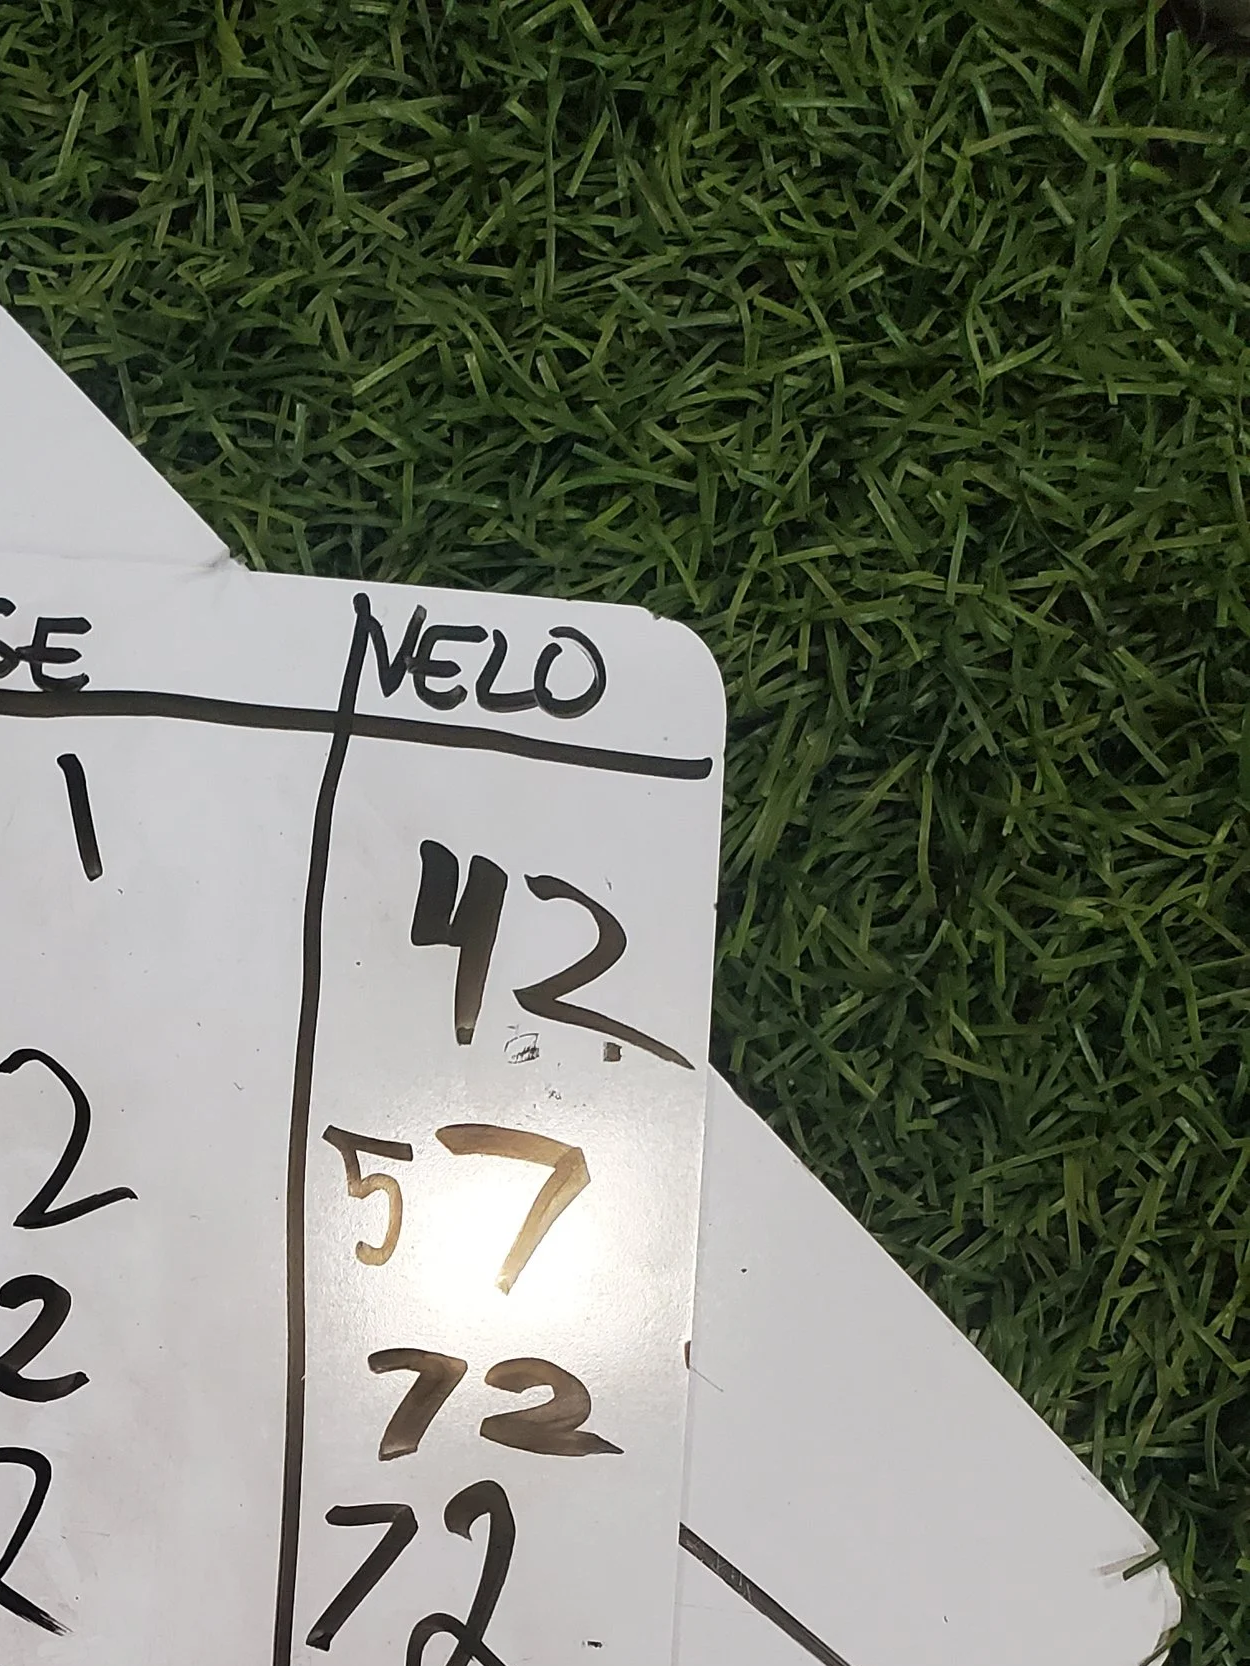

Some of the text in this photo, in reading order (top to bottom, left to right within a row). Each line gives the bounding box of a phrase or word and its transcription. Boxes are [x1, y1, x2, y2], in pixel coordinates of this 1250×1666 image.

[410, 838, 696, 1070] 42
[320, 1122, 592, 1297] 57
[367, 1347, 626, 1461] 72
